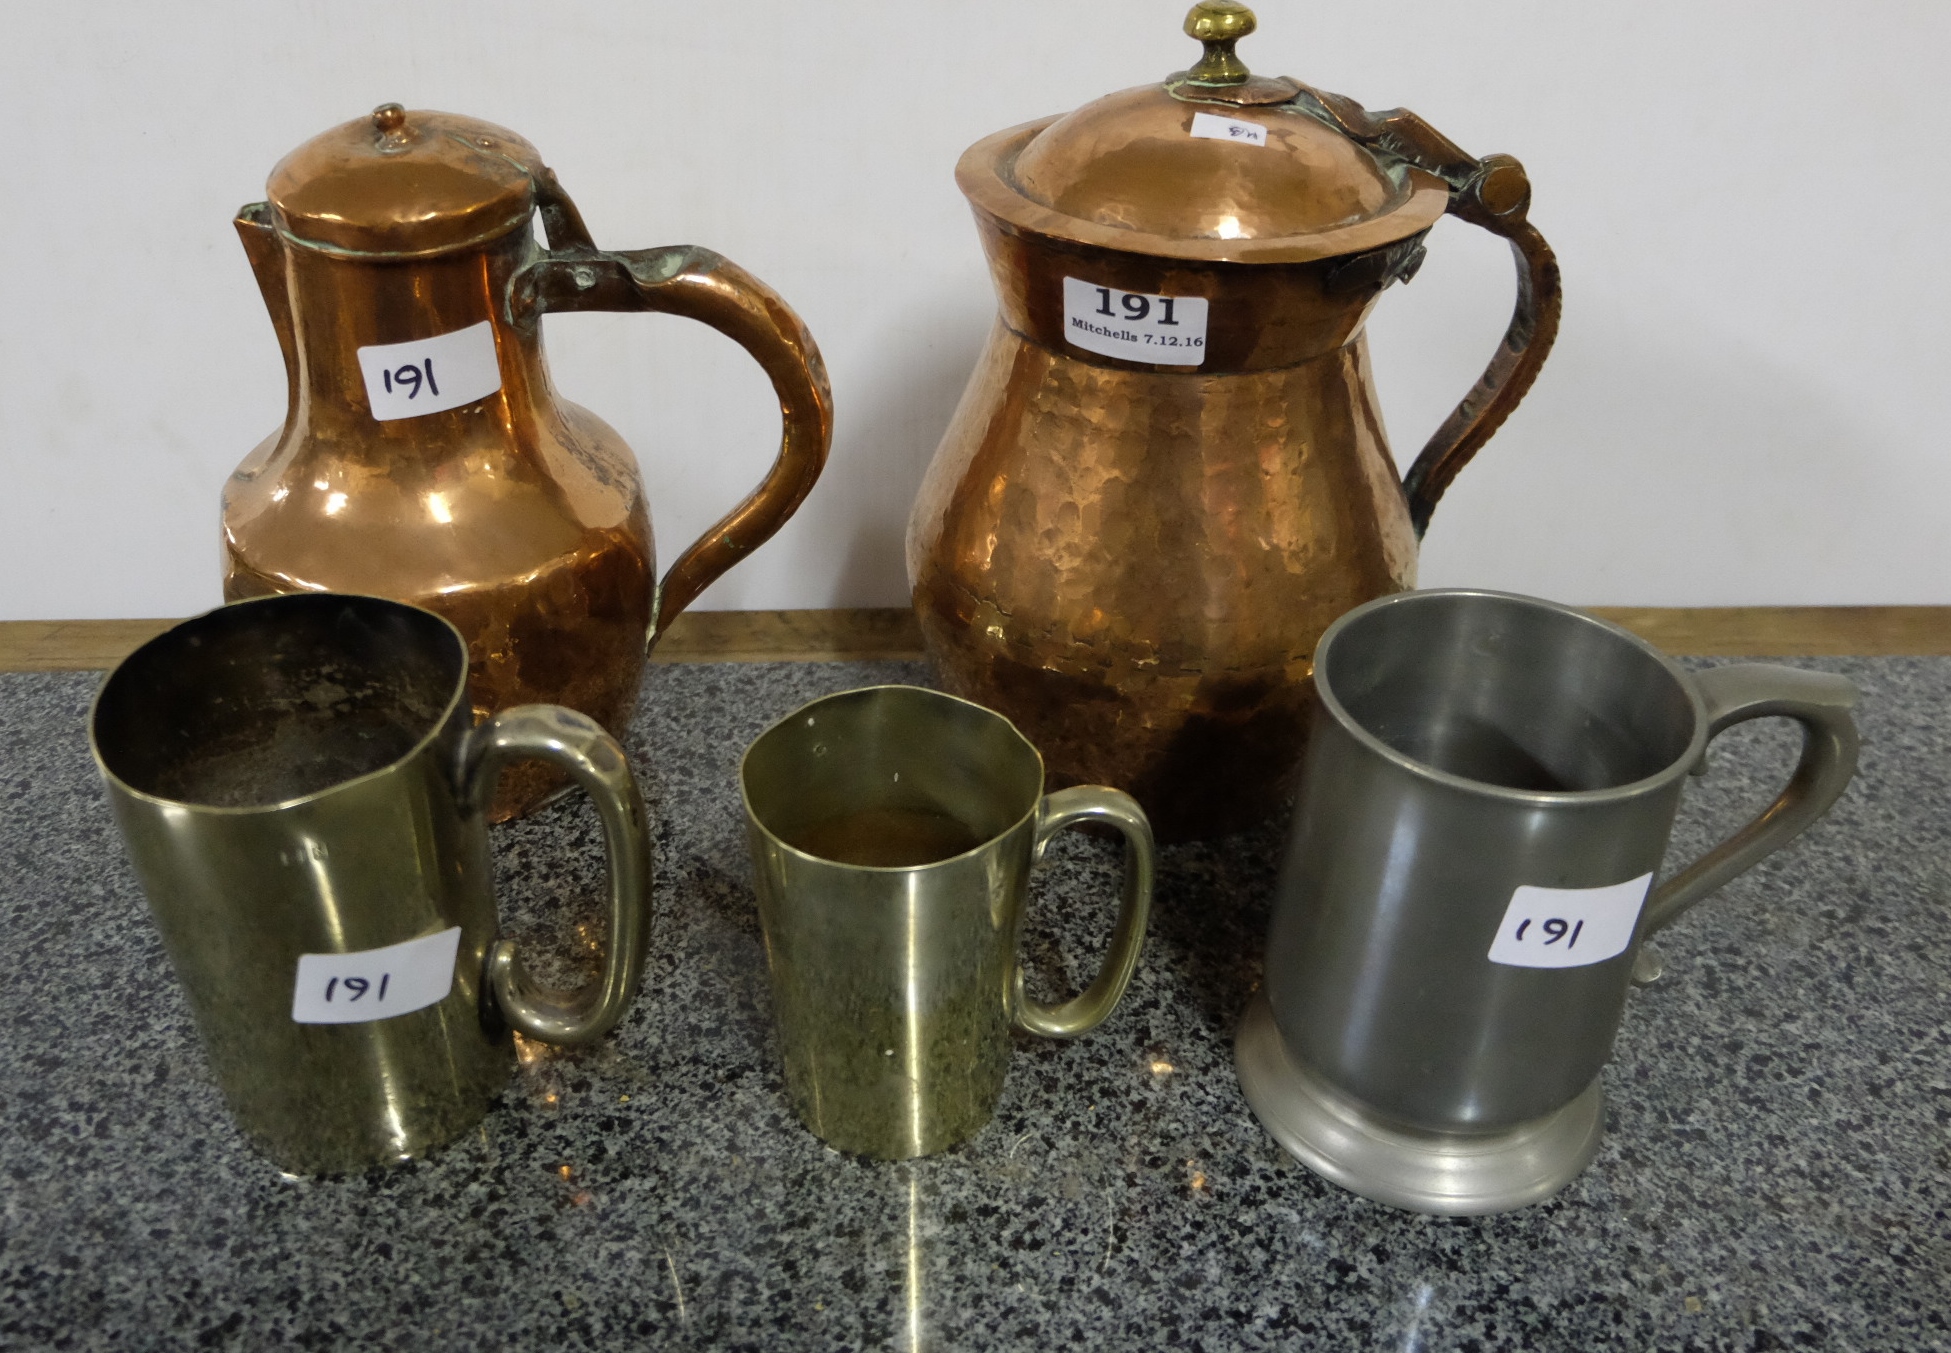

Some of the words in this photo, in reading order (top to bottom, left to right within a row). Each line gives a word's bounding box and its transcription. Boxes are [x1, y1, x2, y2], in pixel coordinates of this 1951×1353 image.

[1095, 287, 1180, 326] 191
[1071, 316, 1139, 343] Mitchells
[1143, 333, 1205, 347] 7.12.16
[383, 357, 440, 400] 191
[1515, 917, 1584, 950] 191
[325, 973, 390, 1003] 191
